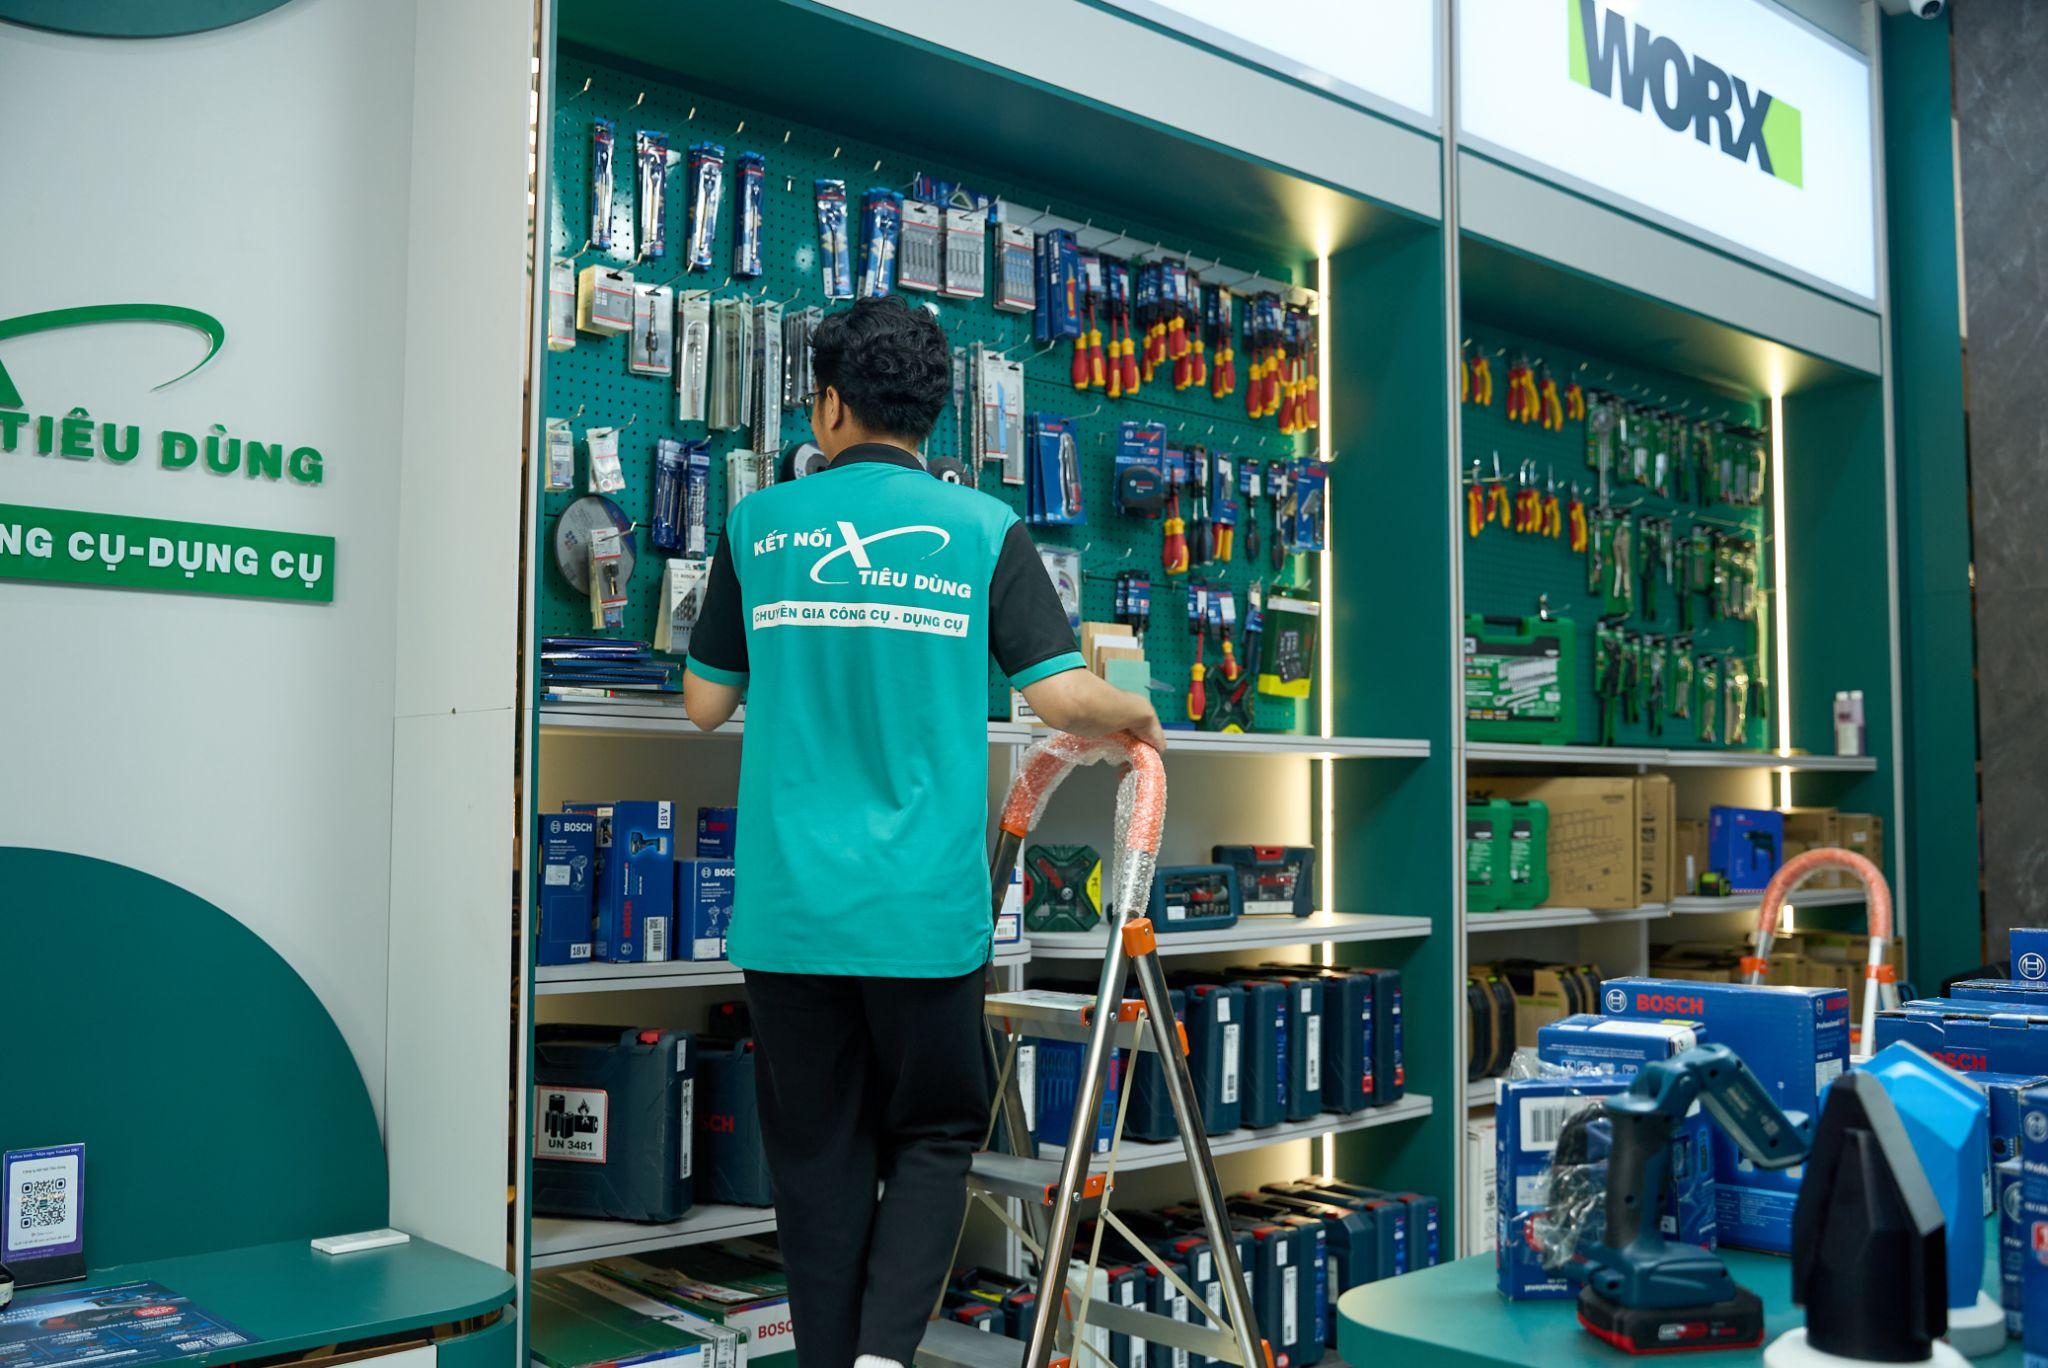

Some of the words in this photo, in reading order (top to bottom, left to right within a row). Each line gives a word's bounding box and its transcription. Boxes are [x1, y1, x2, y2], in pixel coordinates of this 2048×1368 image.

[1579, 0, 1775, 177] WORX
[0, 406, 141, 463] TIÊU
[161, 423, 324, 484] DÙNG
[753, 530, 788, 557] KẾT
[793, 527, 832, 548] NỐI
[270, 550, 323, 588] CỤ
[858, 567, 907, 588] TIÊU
[914, 573, 972, 599] DÙNG
[754, 604, 798, 623] CHUYÊN
[802, 607, 825, 619] GIA
[829, 606, 866, 620] CÔNG
[870, 609, 890, 623] CỤ
[902, 612, 940, 628] DỤNG
[943, 618, 963, 633] CỤ
[563, 822, 593, 833] BOSCH
[1636, 993, 1704, 1015] BOSCH
[548, 1139, 565, 1149] UN
[567, 1140, 593, 1151] 3481
